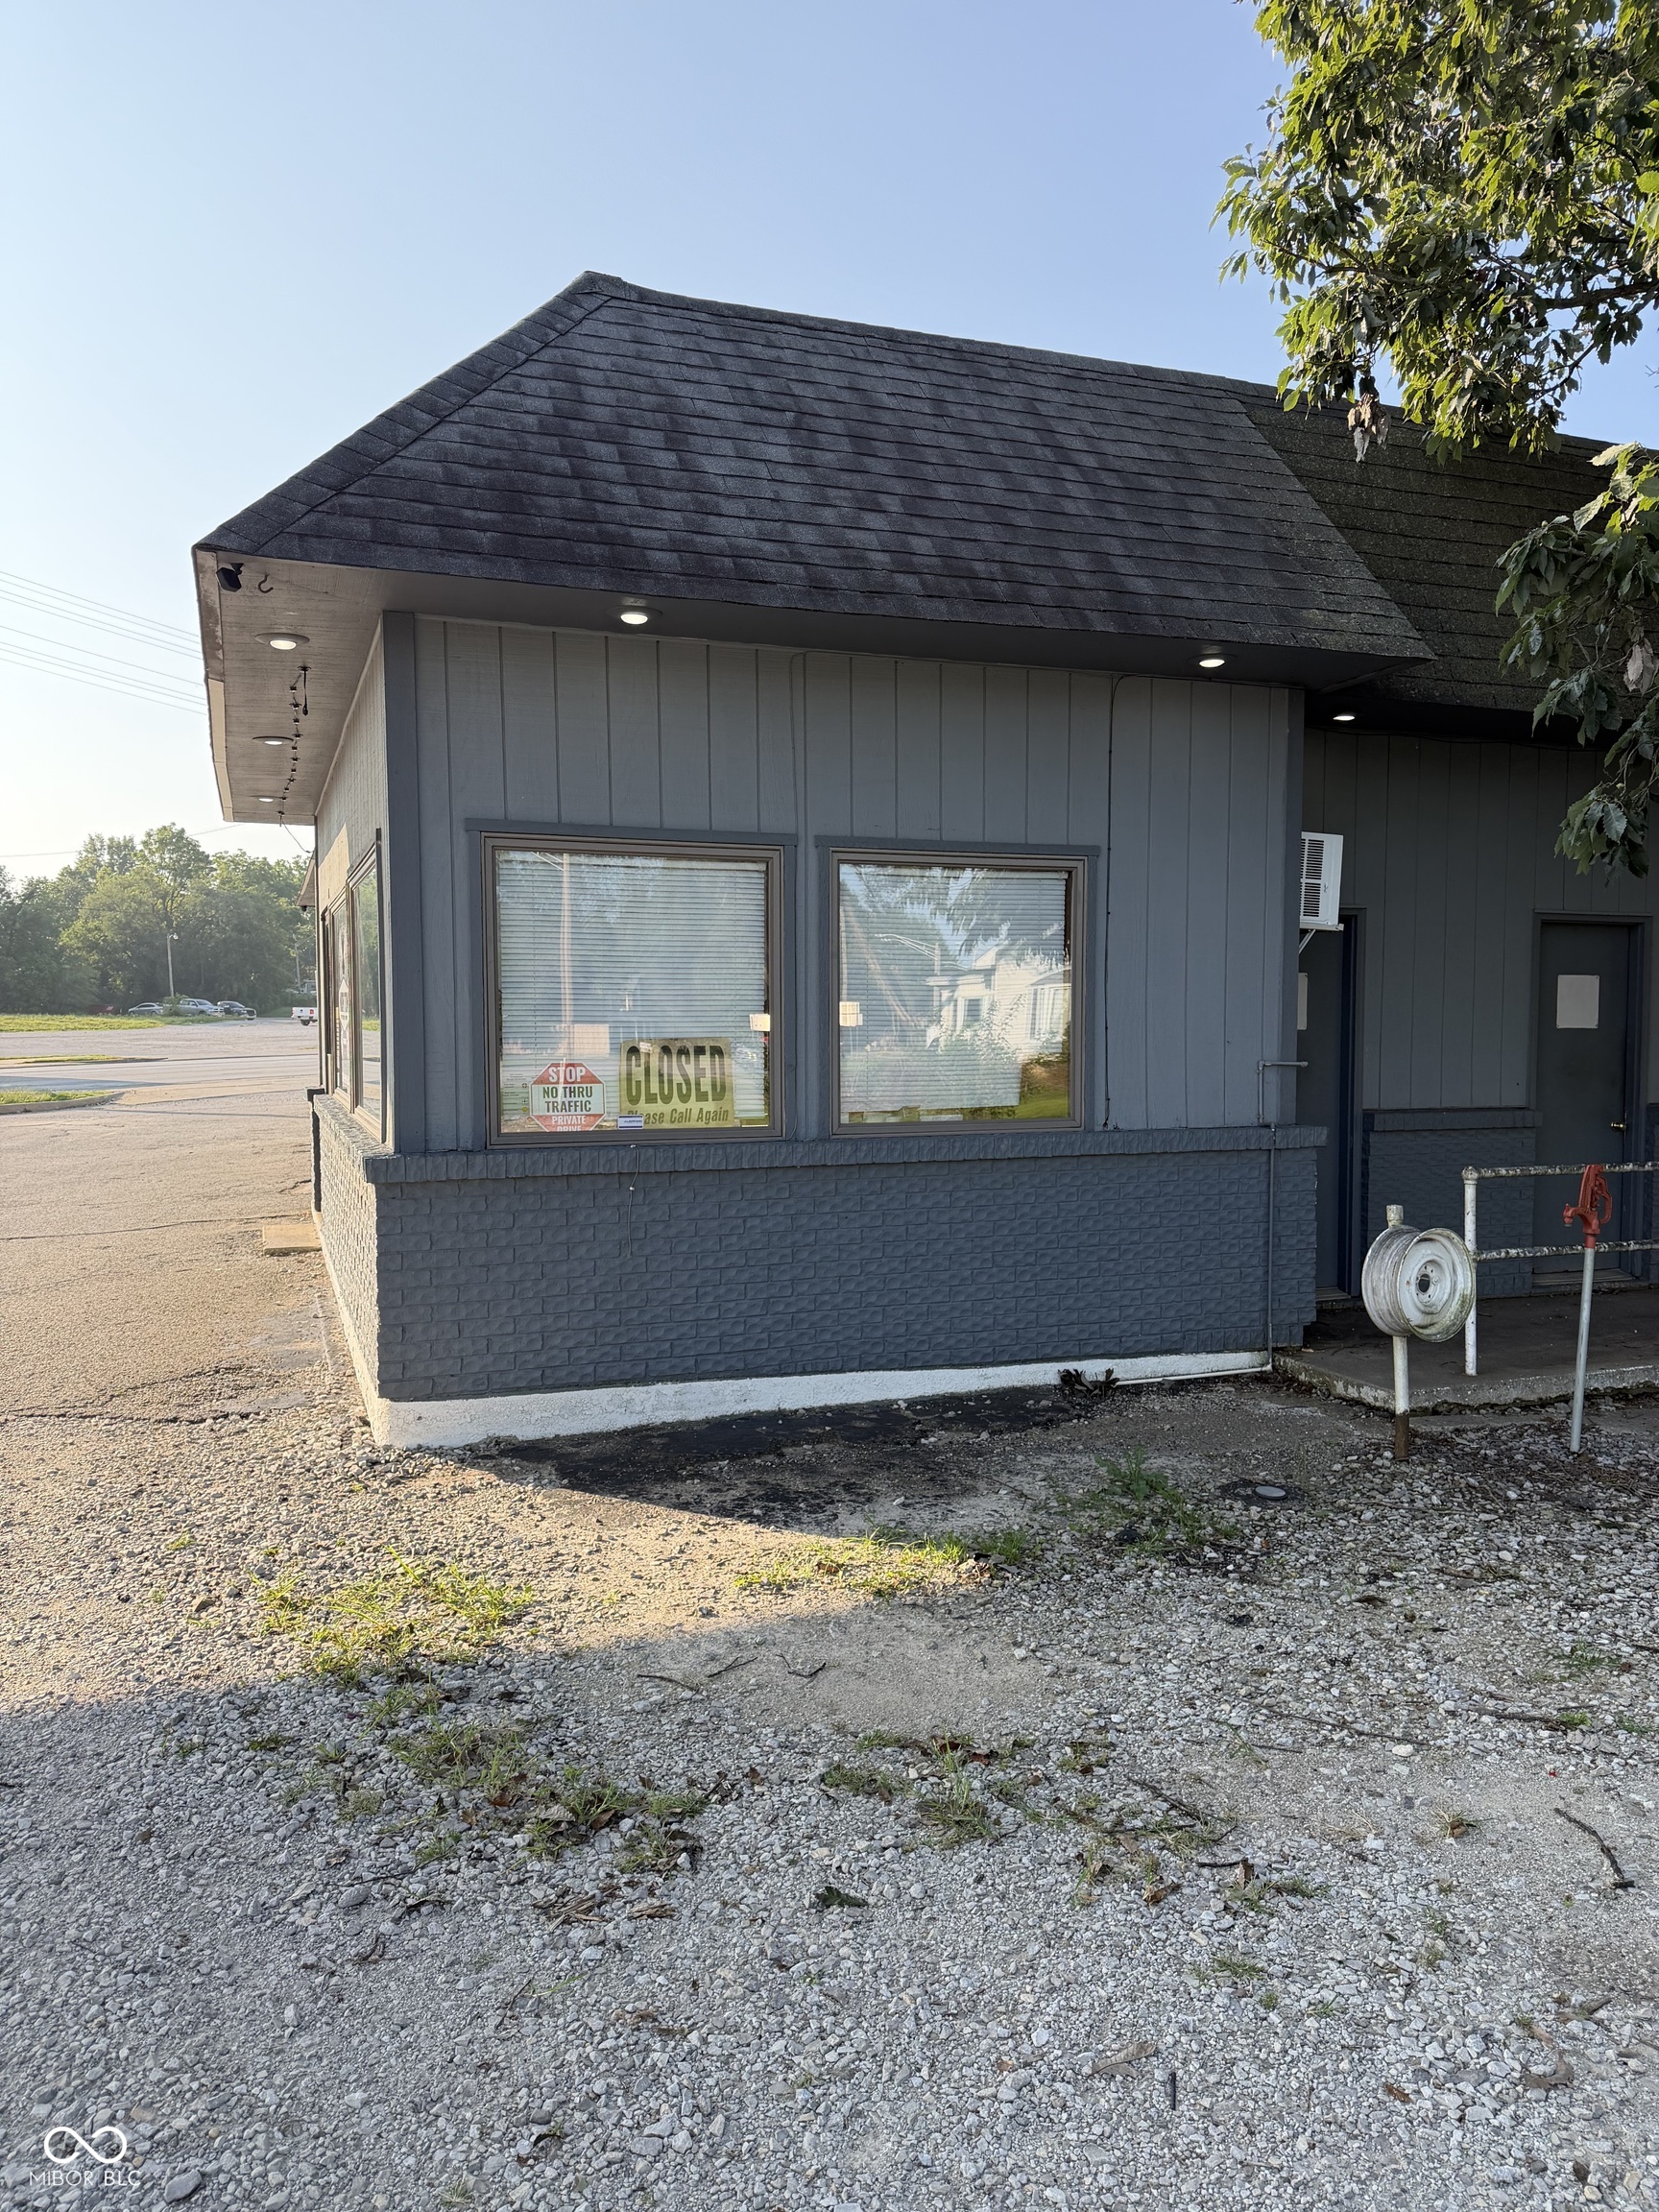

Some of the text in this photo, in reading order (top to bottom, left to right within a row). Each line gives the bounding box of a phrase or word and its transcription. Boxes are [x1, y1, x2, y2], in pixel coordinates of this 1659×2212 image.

[548, 1066, 587, 1083] STOP
[626, 1045, 727, 1106] CLOSED
[542, 1086, 592, 1098] NO THRU
[545, 1100, 591, 1113] TRAFFIC
[551, 1115, 587, 1125] PRIVATE
[627, 1106, 729, 1125] ase Call Again
